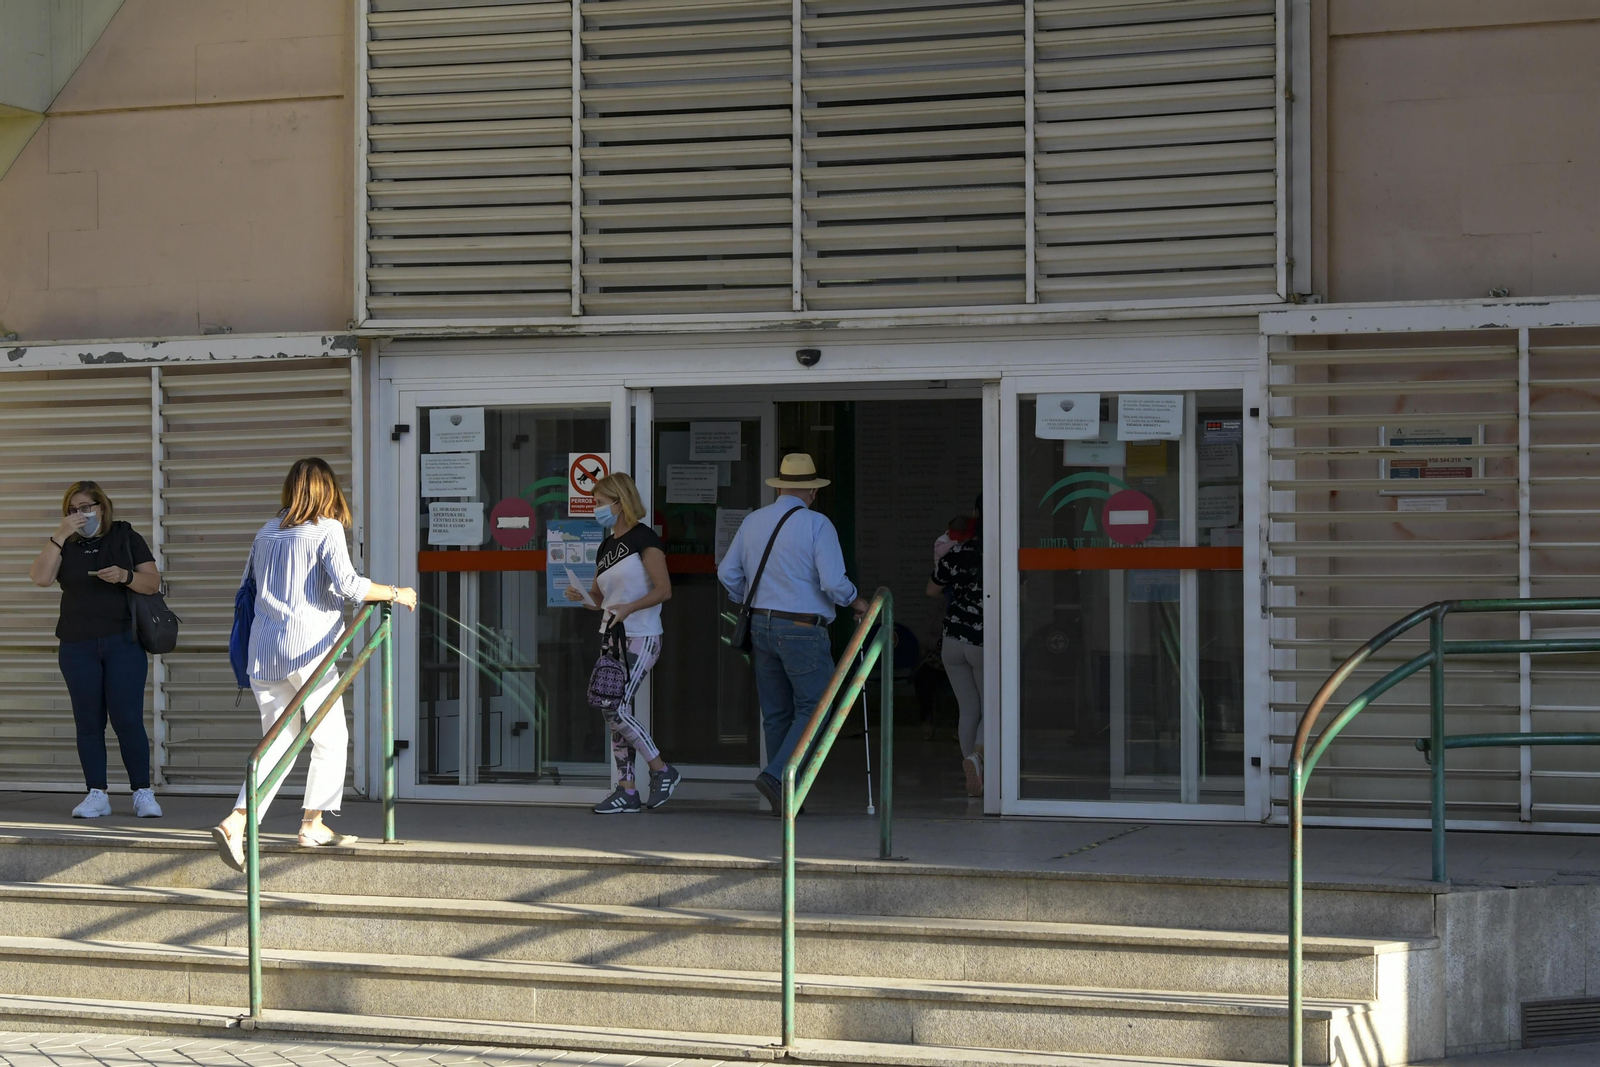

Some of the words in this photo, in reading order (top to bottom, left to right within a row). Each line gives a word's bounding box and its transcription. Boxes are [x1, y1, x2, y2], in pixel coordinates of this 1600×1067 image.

[1038, 538, 1068, 548] JUNTA
[1073, 538, 1085, 548] DE
[595, 542, 629, 574] FILA
